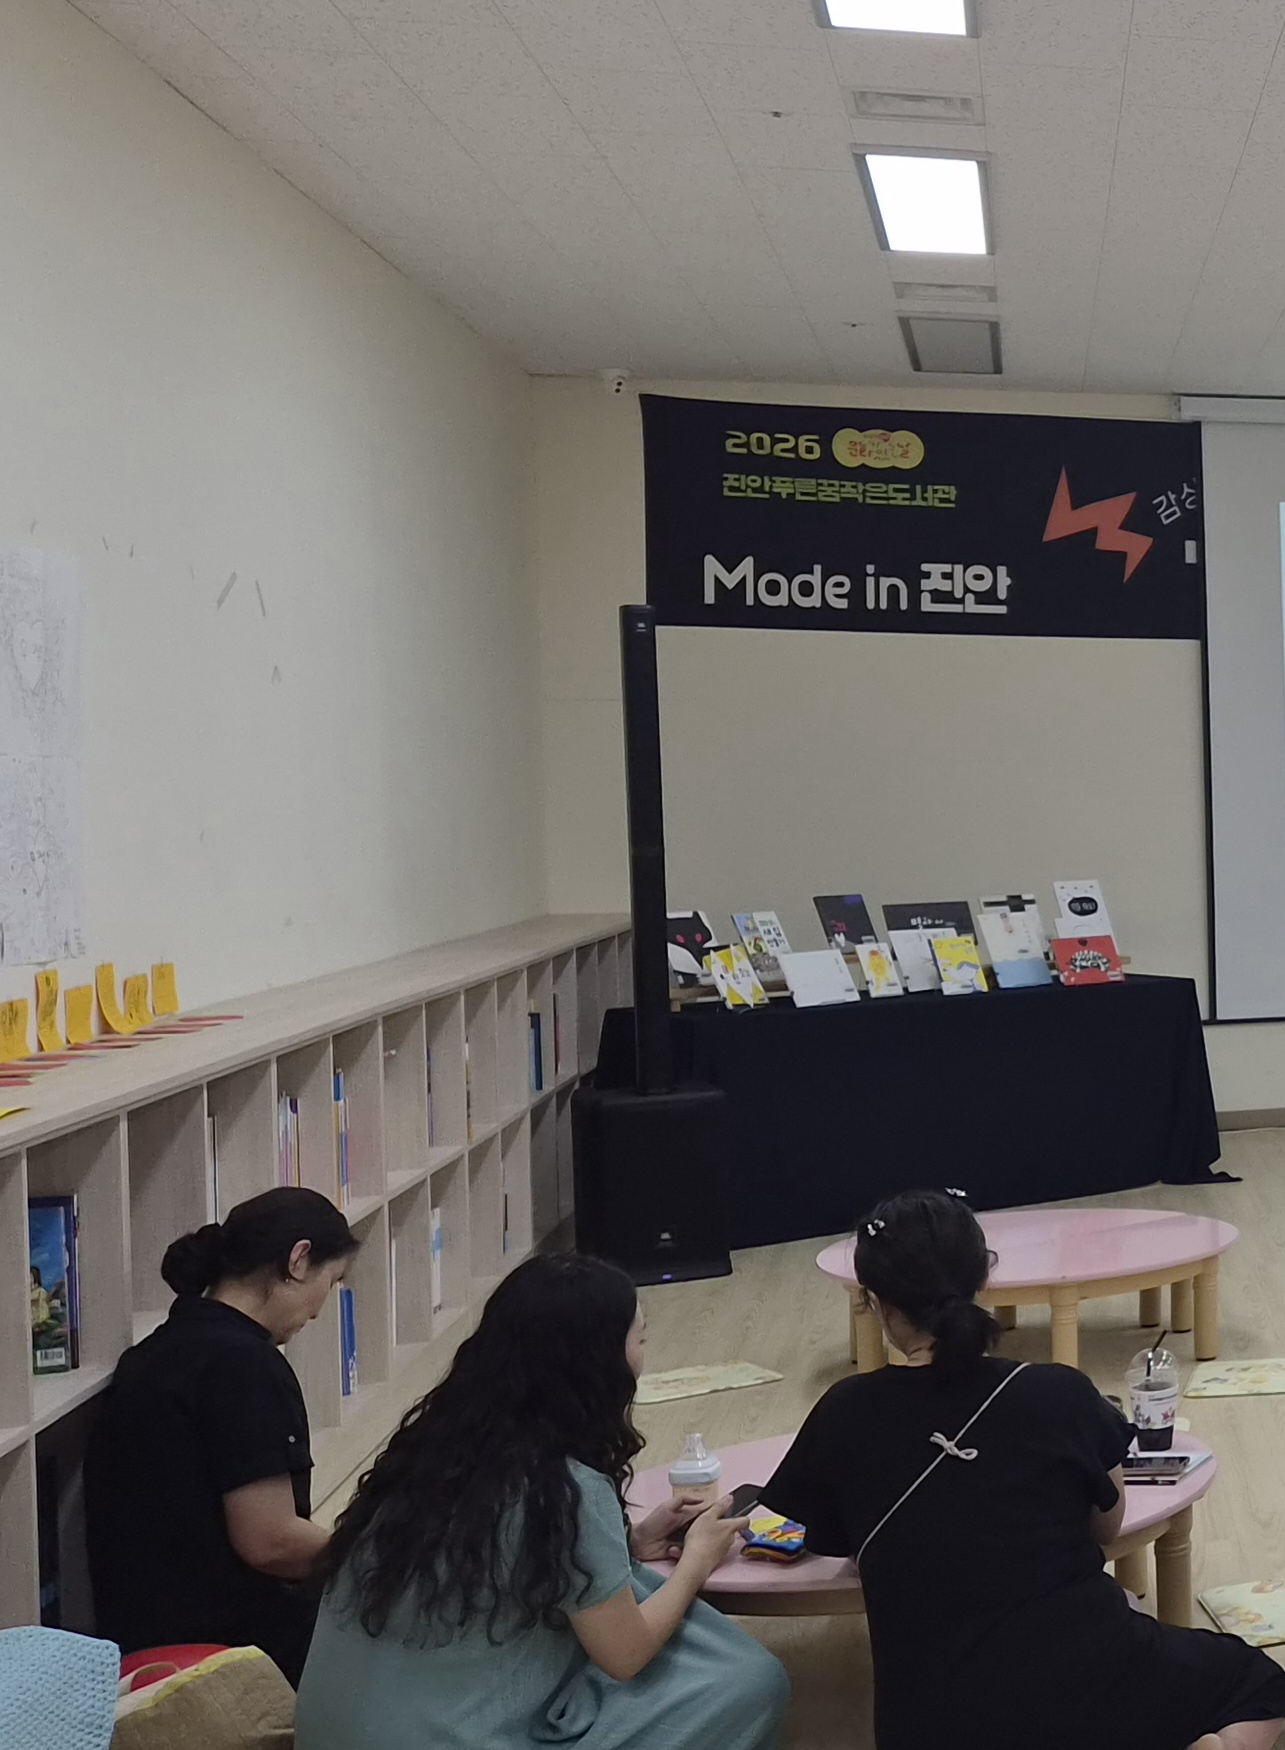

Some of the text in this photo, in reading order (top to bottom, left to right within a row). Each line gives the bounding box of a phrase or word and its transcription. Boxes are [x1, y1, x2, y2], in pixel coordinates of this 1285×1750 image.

[726, 431, 821, 460] 2026
[723, 473, 957, 508] 진안푸른꿈작은도서관
[703, 554, 1012, 614] Made in 진안
